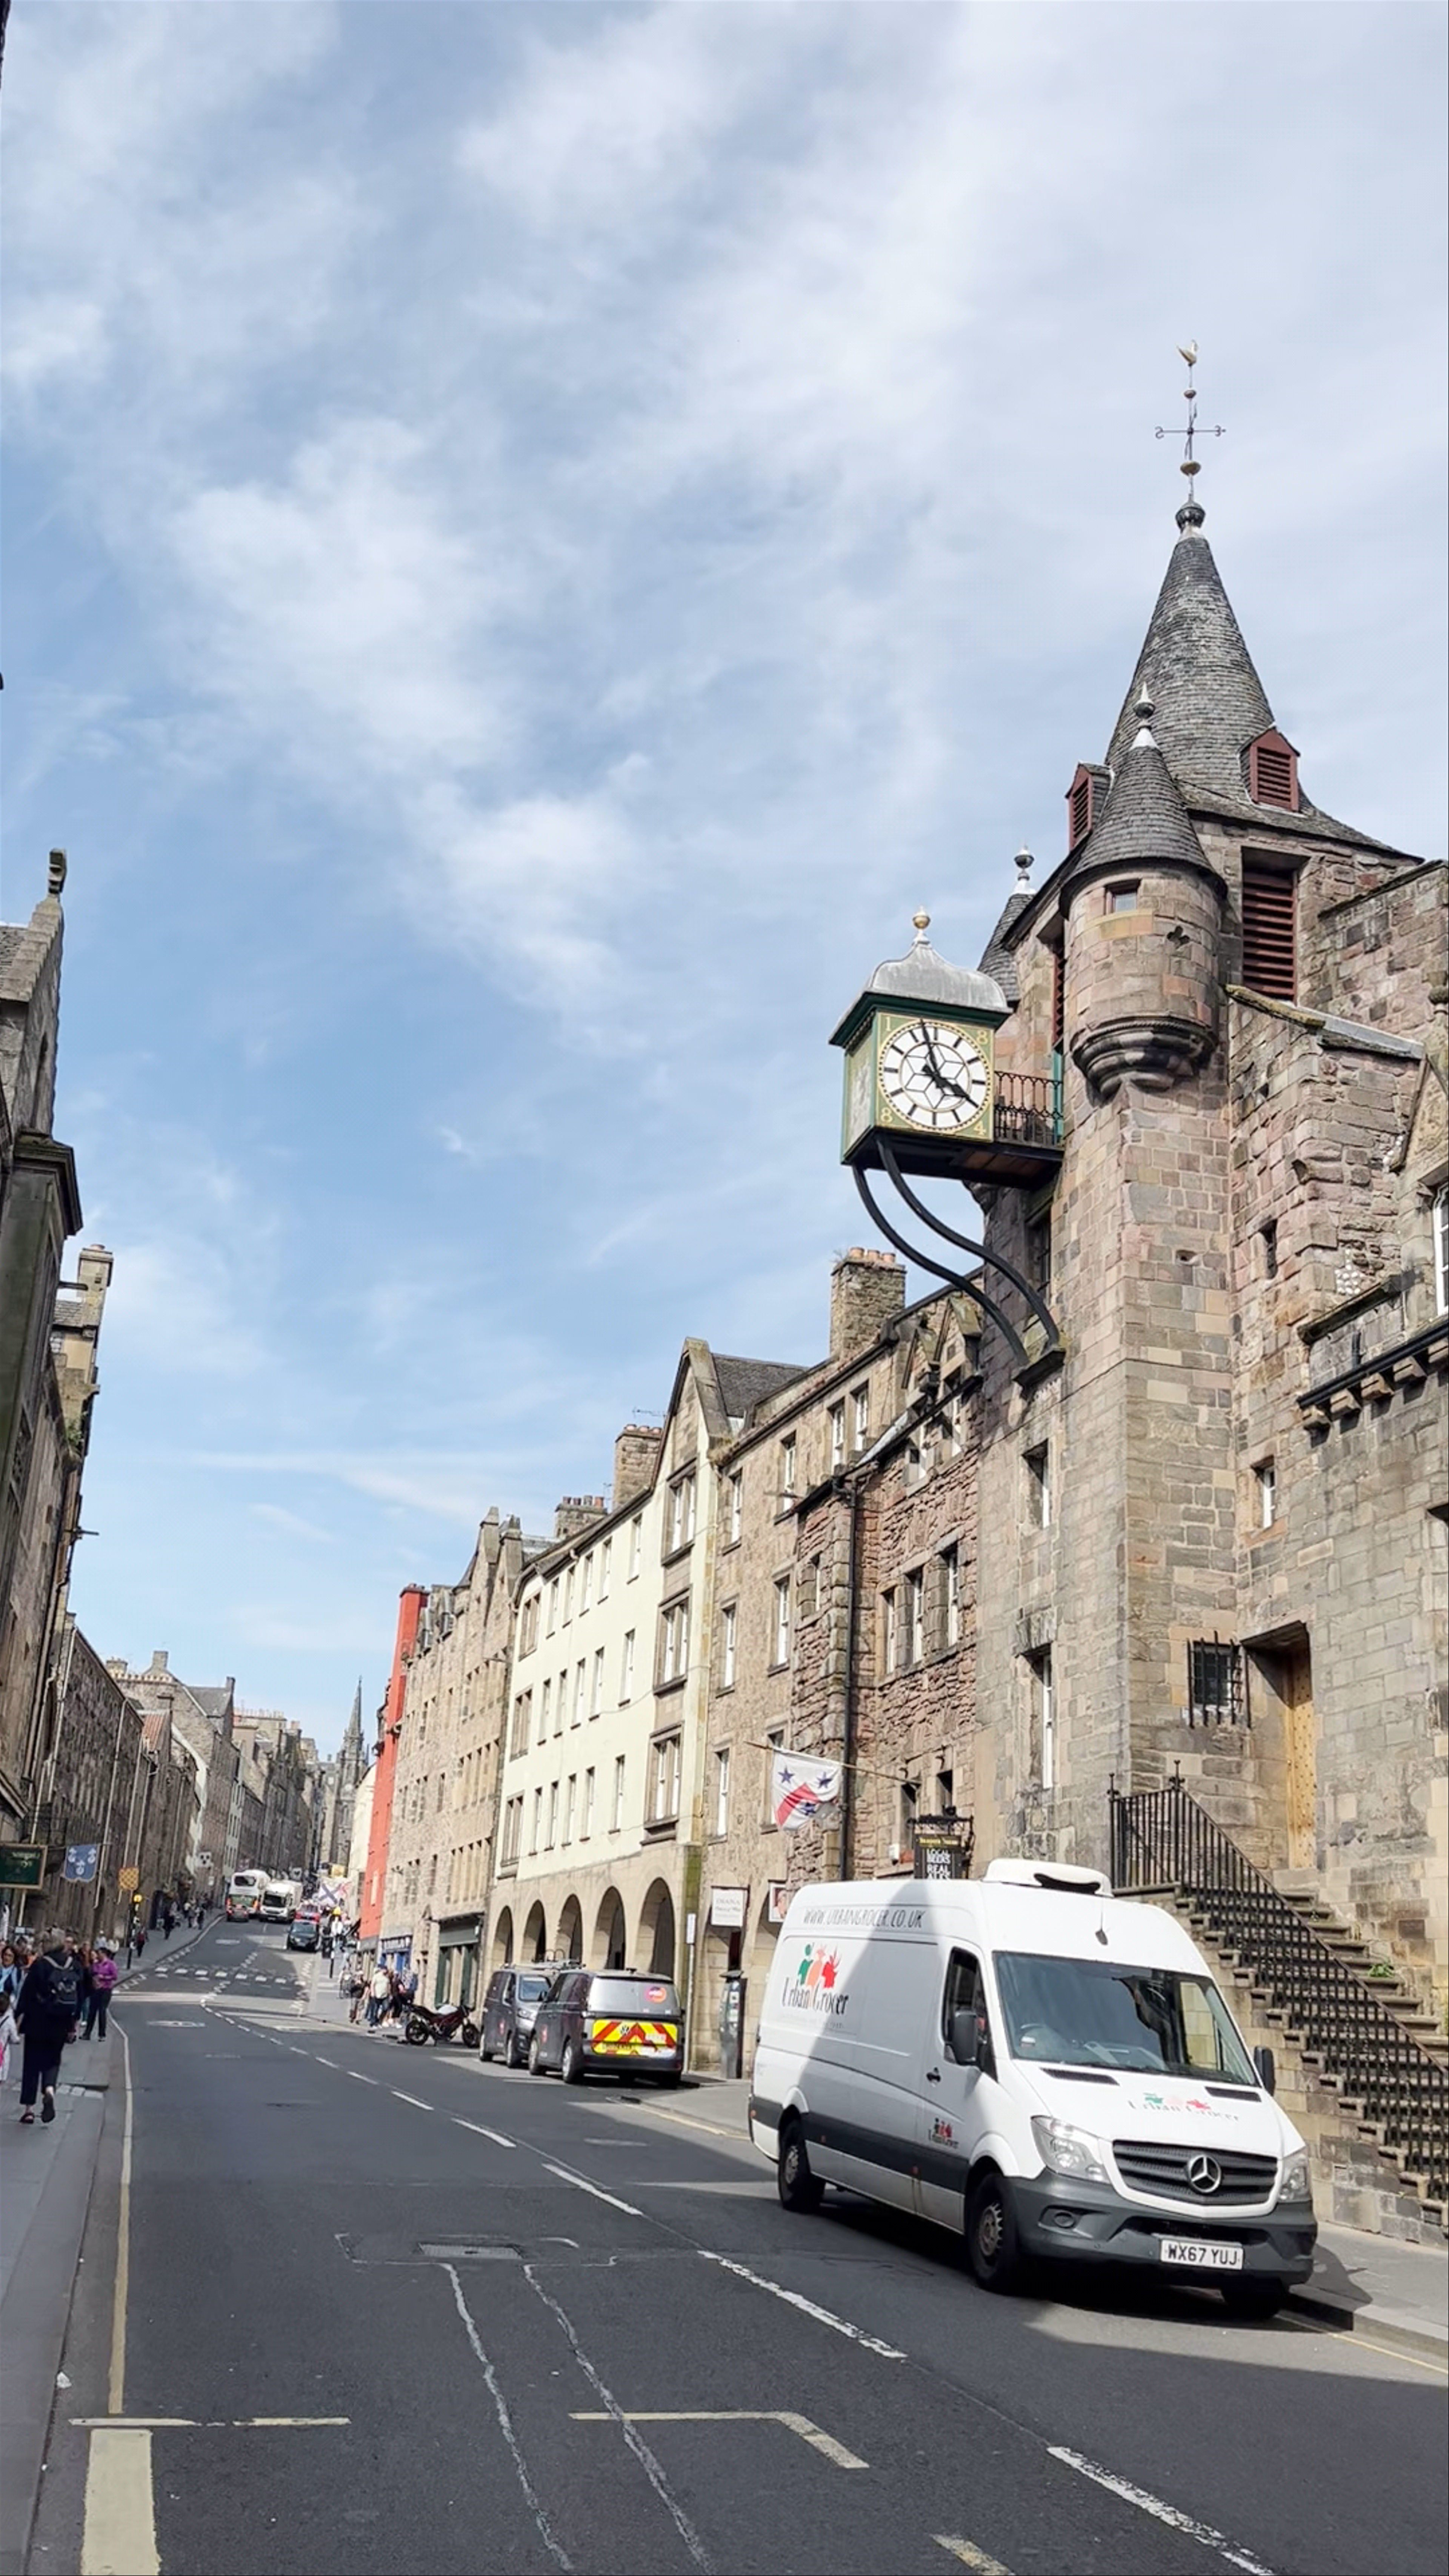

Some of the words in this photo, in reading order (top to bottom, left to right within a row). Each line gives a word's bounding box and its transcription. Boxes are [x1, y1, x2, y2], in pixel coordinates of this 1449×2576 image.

[885, 1016, 891, 1031] 1
[977, 1030, 988, 1044] 8
[881, 1107, 893, 1123] 8
[974, 1121, 986, 1135] 4
[927, 1864, 949, 1873] REAL
[1168, 2243, 1206, 2263] WX67
[1211, 2248, 1237, 2265] YUJ
